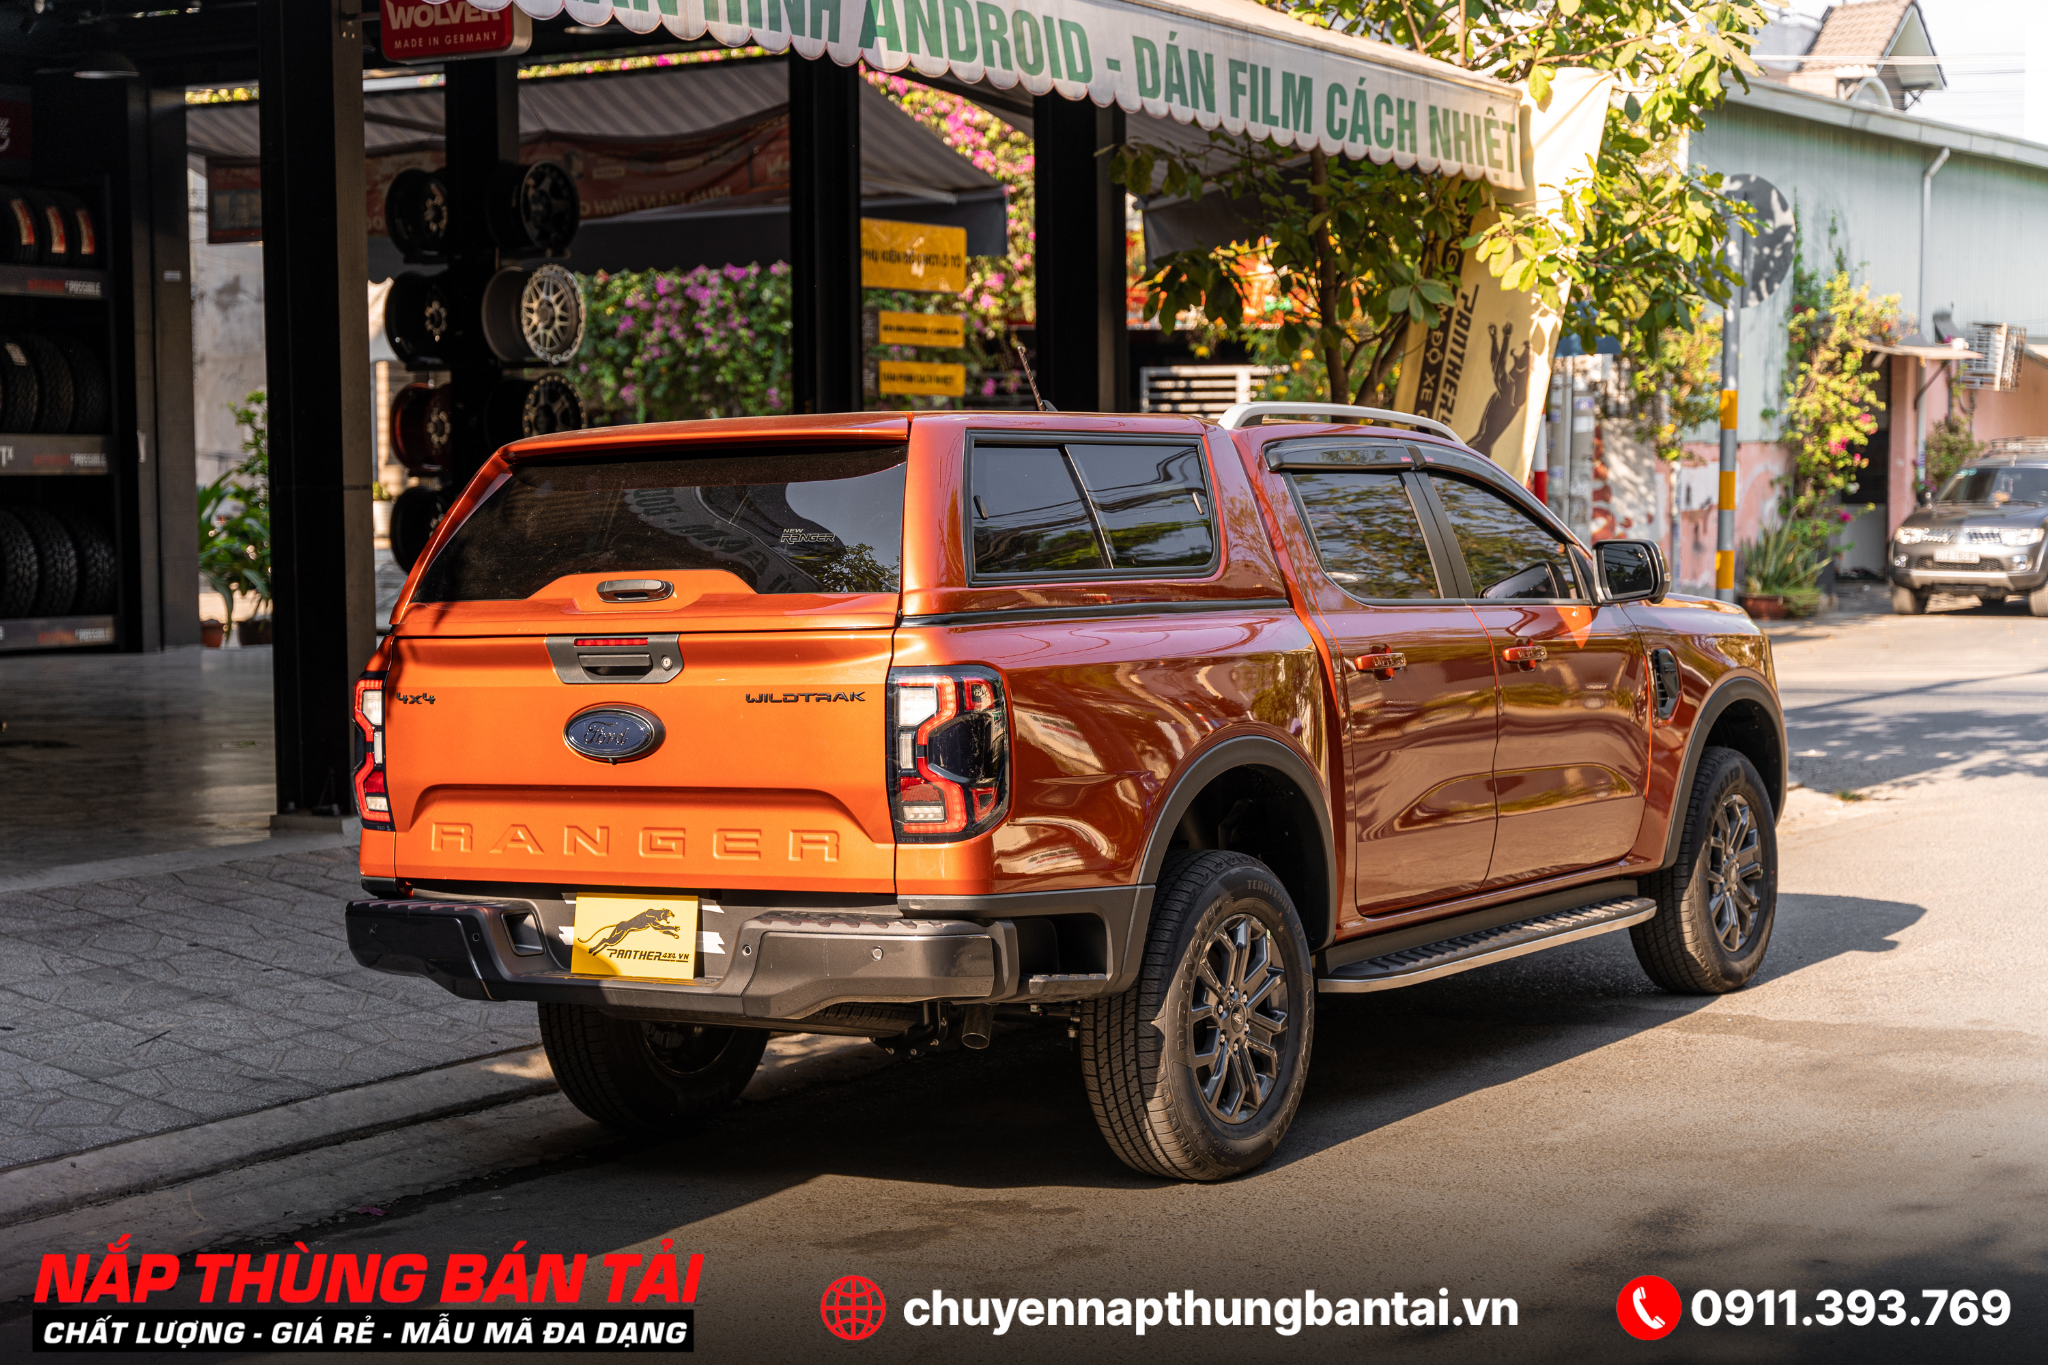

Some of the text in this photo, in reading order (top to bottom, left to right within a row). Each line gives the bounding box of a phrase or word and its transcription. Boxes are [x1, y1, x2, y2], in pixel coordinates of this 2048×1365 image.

[394, 31, 498, 50] MADE IN GERMANY
[858, 0, 1093, 84] ANDROID
[1132, 30, 1216, 114] DÁN
[1228, 57, 1314, 135] FILM
[1326, 76, 1418, 155] CÁCH
[1428, 106, 1516, 182] NHIỆT
[1425, 330, 1444, 366] ĐỘ
[1420, 372, 1438, 402] XE
[395, 691, 436, 705] 4x4
[745, 691, 866, 704] WILDTRAK
[583, 721, 630, 746] Ford
[430, 822, 840, 864] RANGER
[1246, 879, 1293, 915] TERRITORY
